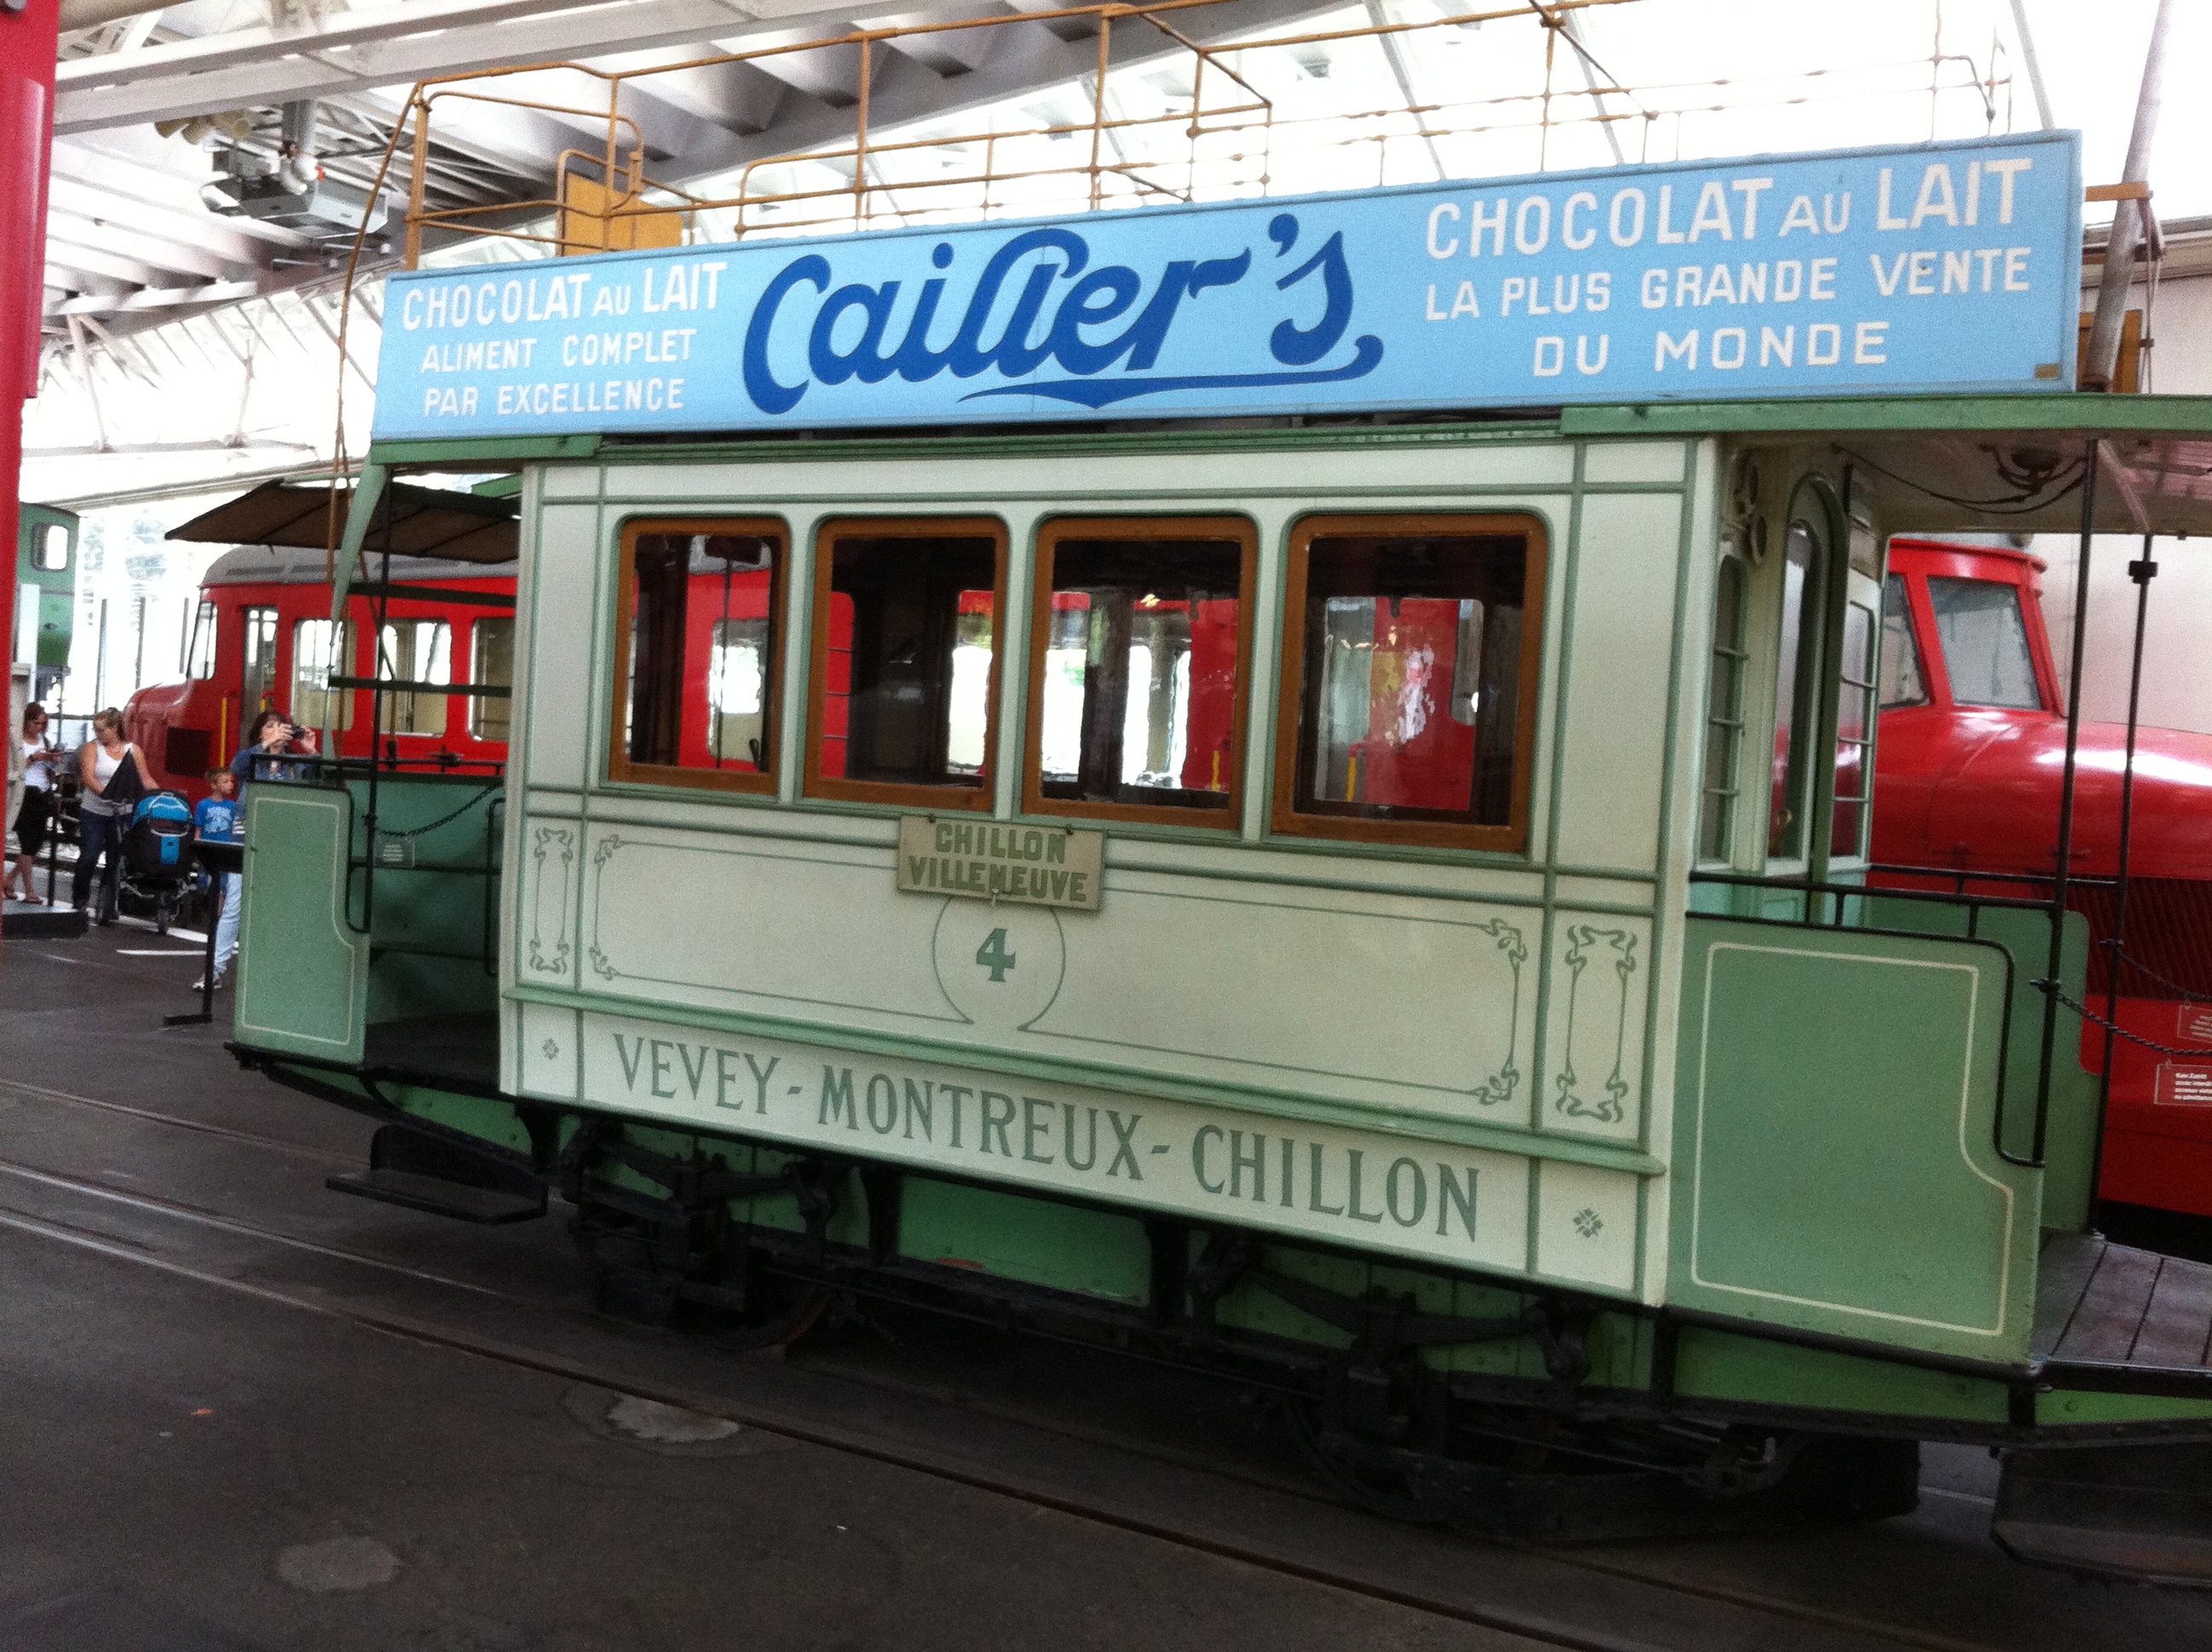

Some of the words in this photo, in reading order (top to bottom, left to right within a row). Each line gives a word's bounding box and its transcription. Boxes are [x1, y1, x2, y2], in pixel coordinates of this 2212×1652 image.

[1426, 177, 1773, 259] CHOCOLAT
[1778, 192, 1851, 237] AU
[1877, 158, 2033, 230] LAIT
[403, 273, 591, 330] CHOCOLAT
[591, 284, 631, 317] AU
[643, 261, 727, 312] LAIT
[1425, 281, 1481, 322] LA
[1500, 272, 1611, 317] PLUS
[1640, 258, 1838, 309] GRANDE
[1869, 247, 2032, 296] VENTE
[742, 213, 1357, 415] Cailler's
[421, 338, 537, 373] ALIMENT
[562, 328, 696, 367] COMPLET
[1533, 334, 1609, 376] DU
[1654, 322, 1889, 372] MONDE
[424, 386, 478, 416] PAR
[498, 378, 684, 415] EXCELLENCE
[935, 823, 1067, 864] CHILLON
[908, 856, 1088, 902] VILLENEUVE
[975, 928, 1016, 982] 4
[1192, 1124, 1480, 1242] CHILLON
